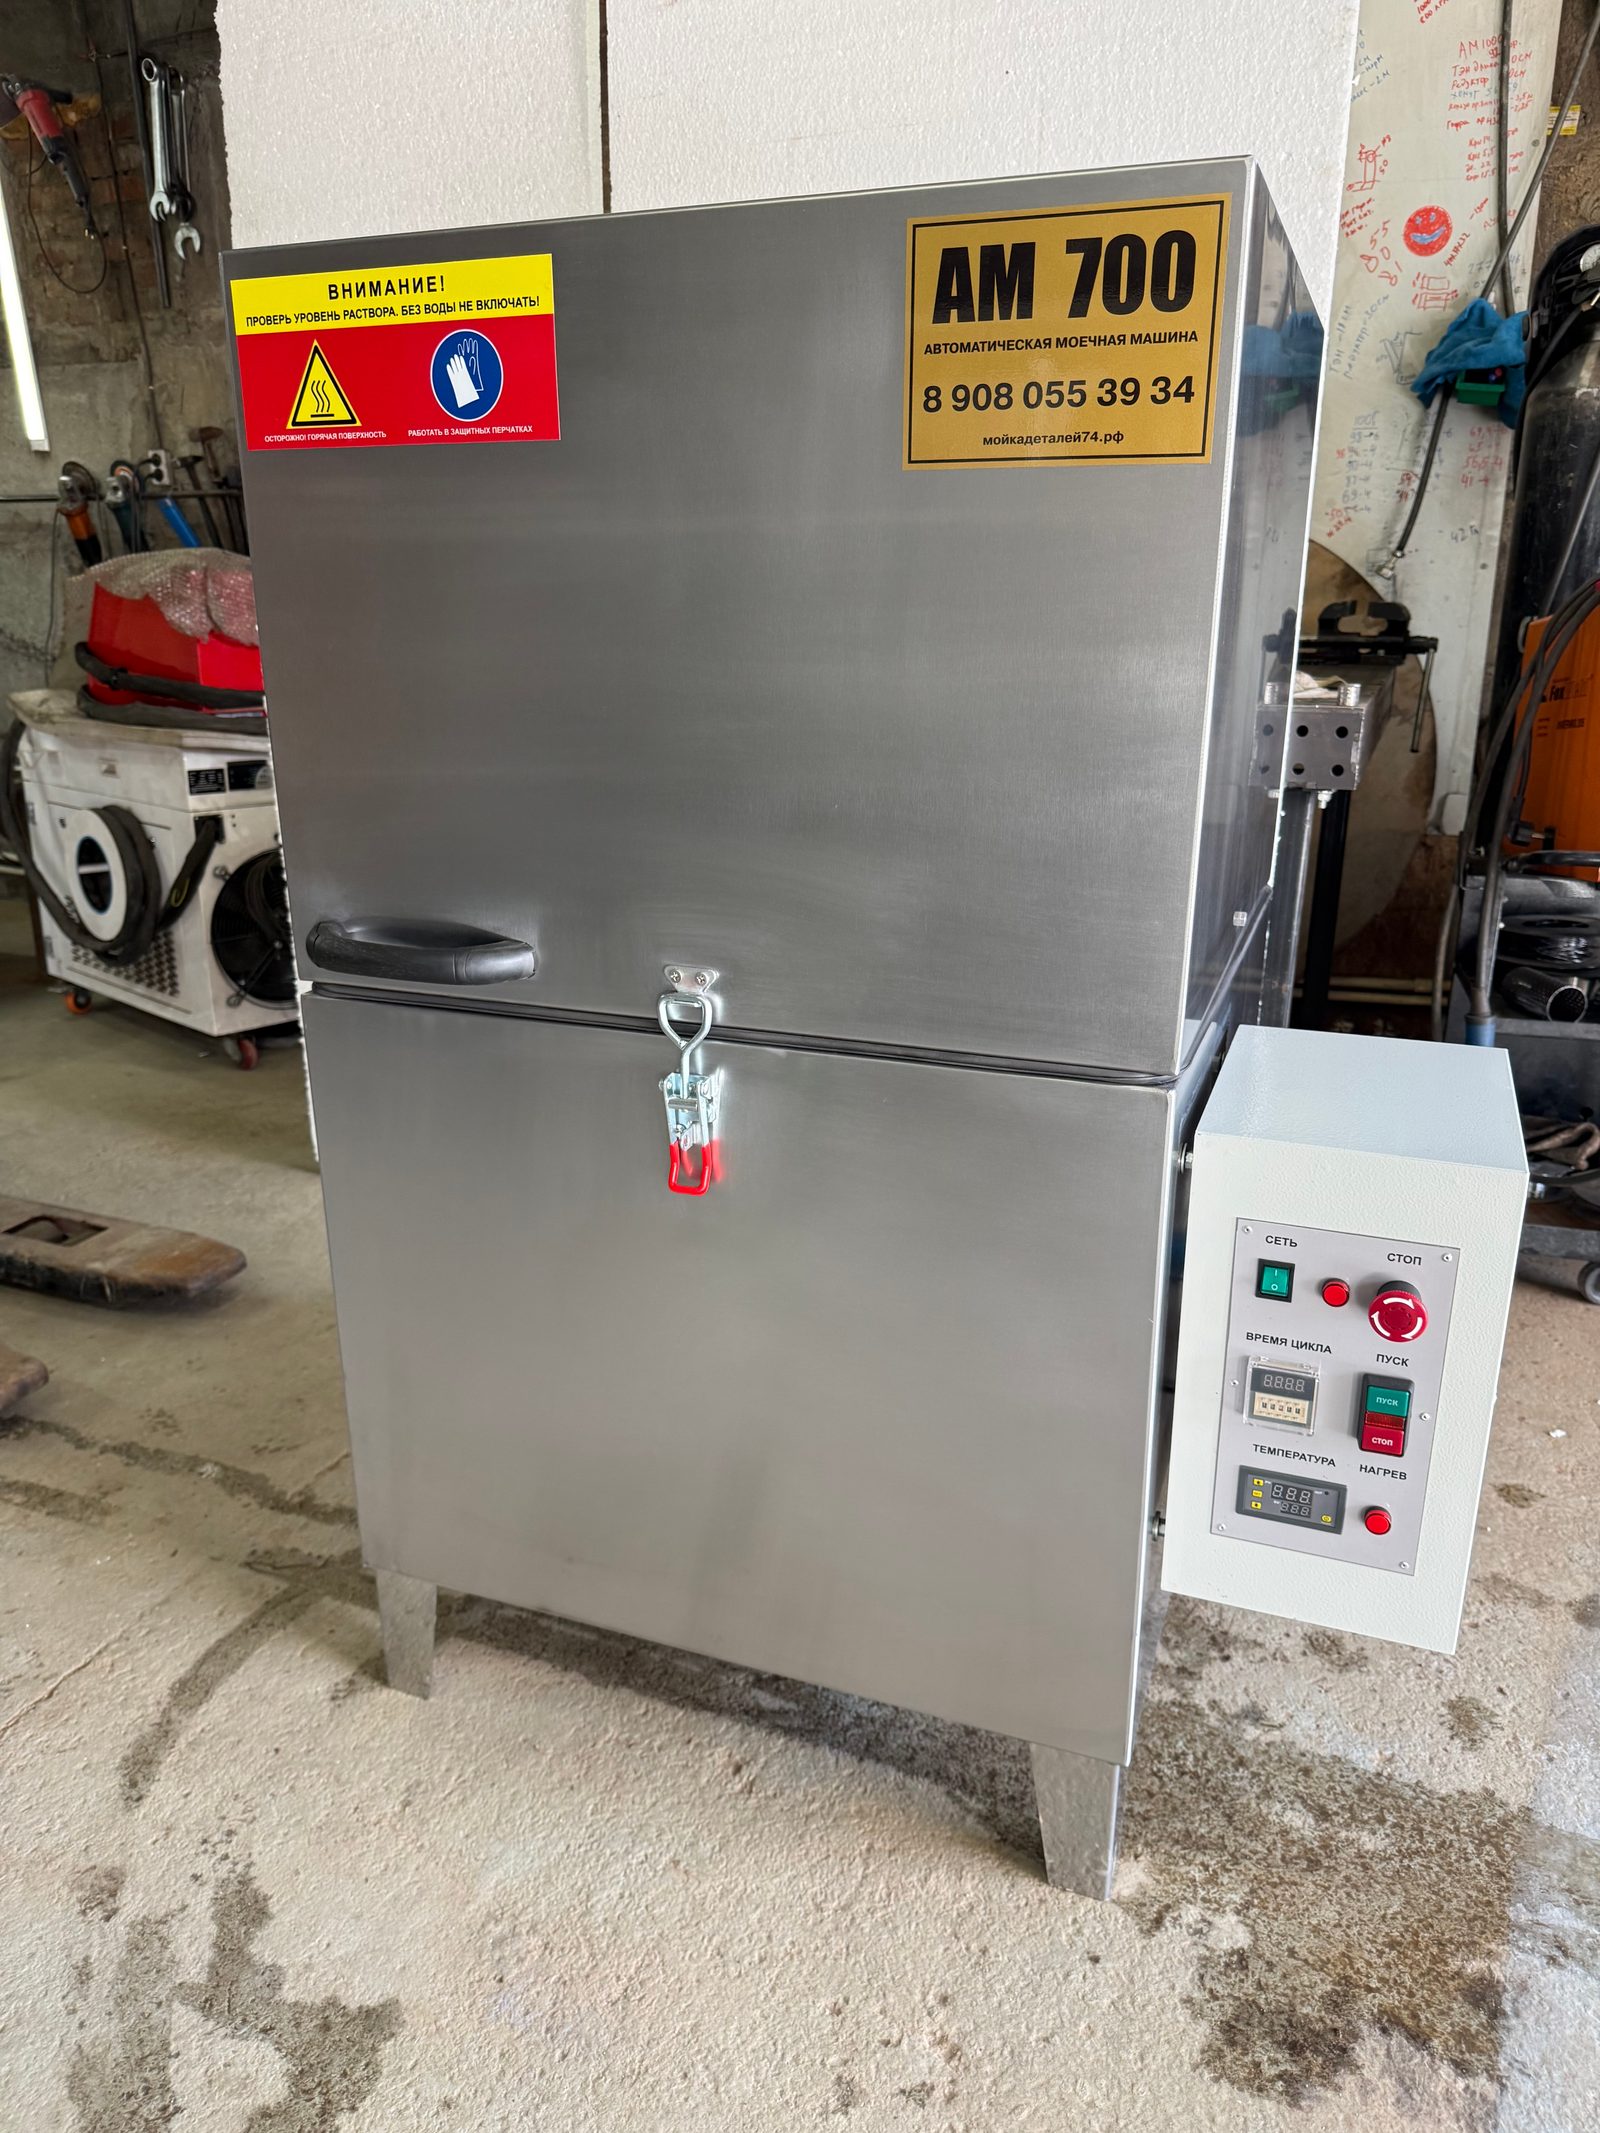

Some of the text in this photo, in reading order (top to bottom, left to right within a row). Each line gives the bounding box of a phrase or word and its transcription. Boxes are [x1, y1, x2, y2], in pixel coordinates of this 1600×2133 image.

[932, 230, 1197, 324] АМ 700
[328, 275, 445, 300] ВНИМАНИЕ!
[246, 296, 540, 327] ПРОВЕРЬ УРОВЕНЬ РАСТВОРА. БЕЗ ВОДЫ НЕ ВКЛЮЧАТЬ!
[924, 330, 1198, 355] АВТОМАТИЧЕСКАЯ МОЕЧНАЯ МАШИНА
[922, 375, 1195, 413] 8 908 055 39 34
[264, 430, 387, 443] ОСТОРОЖНО! ГОРЯЧАЯ ПОВЕРХНОСТЬ
[408, 425, 533, 437] РАБОТАТЬ В ЗАЩИТНЫХ ПЕРЧАТКАХ
[983, 430, 1124, 446] мойкадеталей74.рф
[1265, 1235, 1298, 1248] СЕТЬ
[1387, 1252, 1422, 1266] СТОП
[1246, 1332, 1332, 1354] ВРЕМЯ ЦИКЛА
[1376, 1353, 1409, 1367] ПУСК
[1252, 1443, 1336, 1467] ТЕМПЕРАТУРА
[1359, 1463, 1407, 1480] НАГРЕВ
